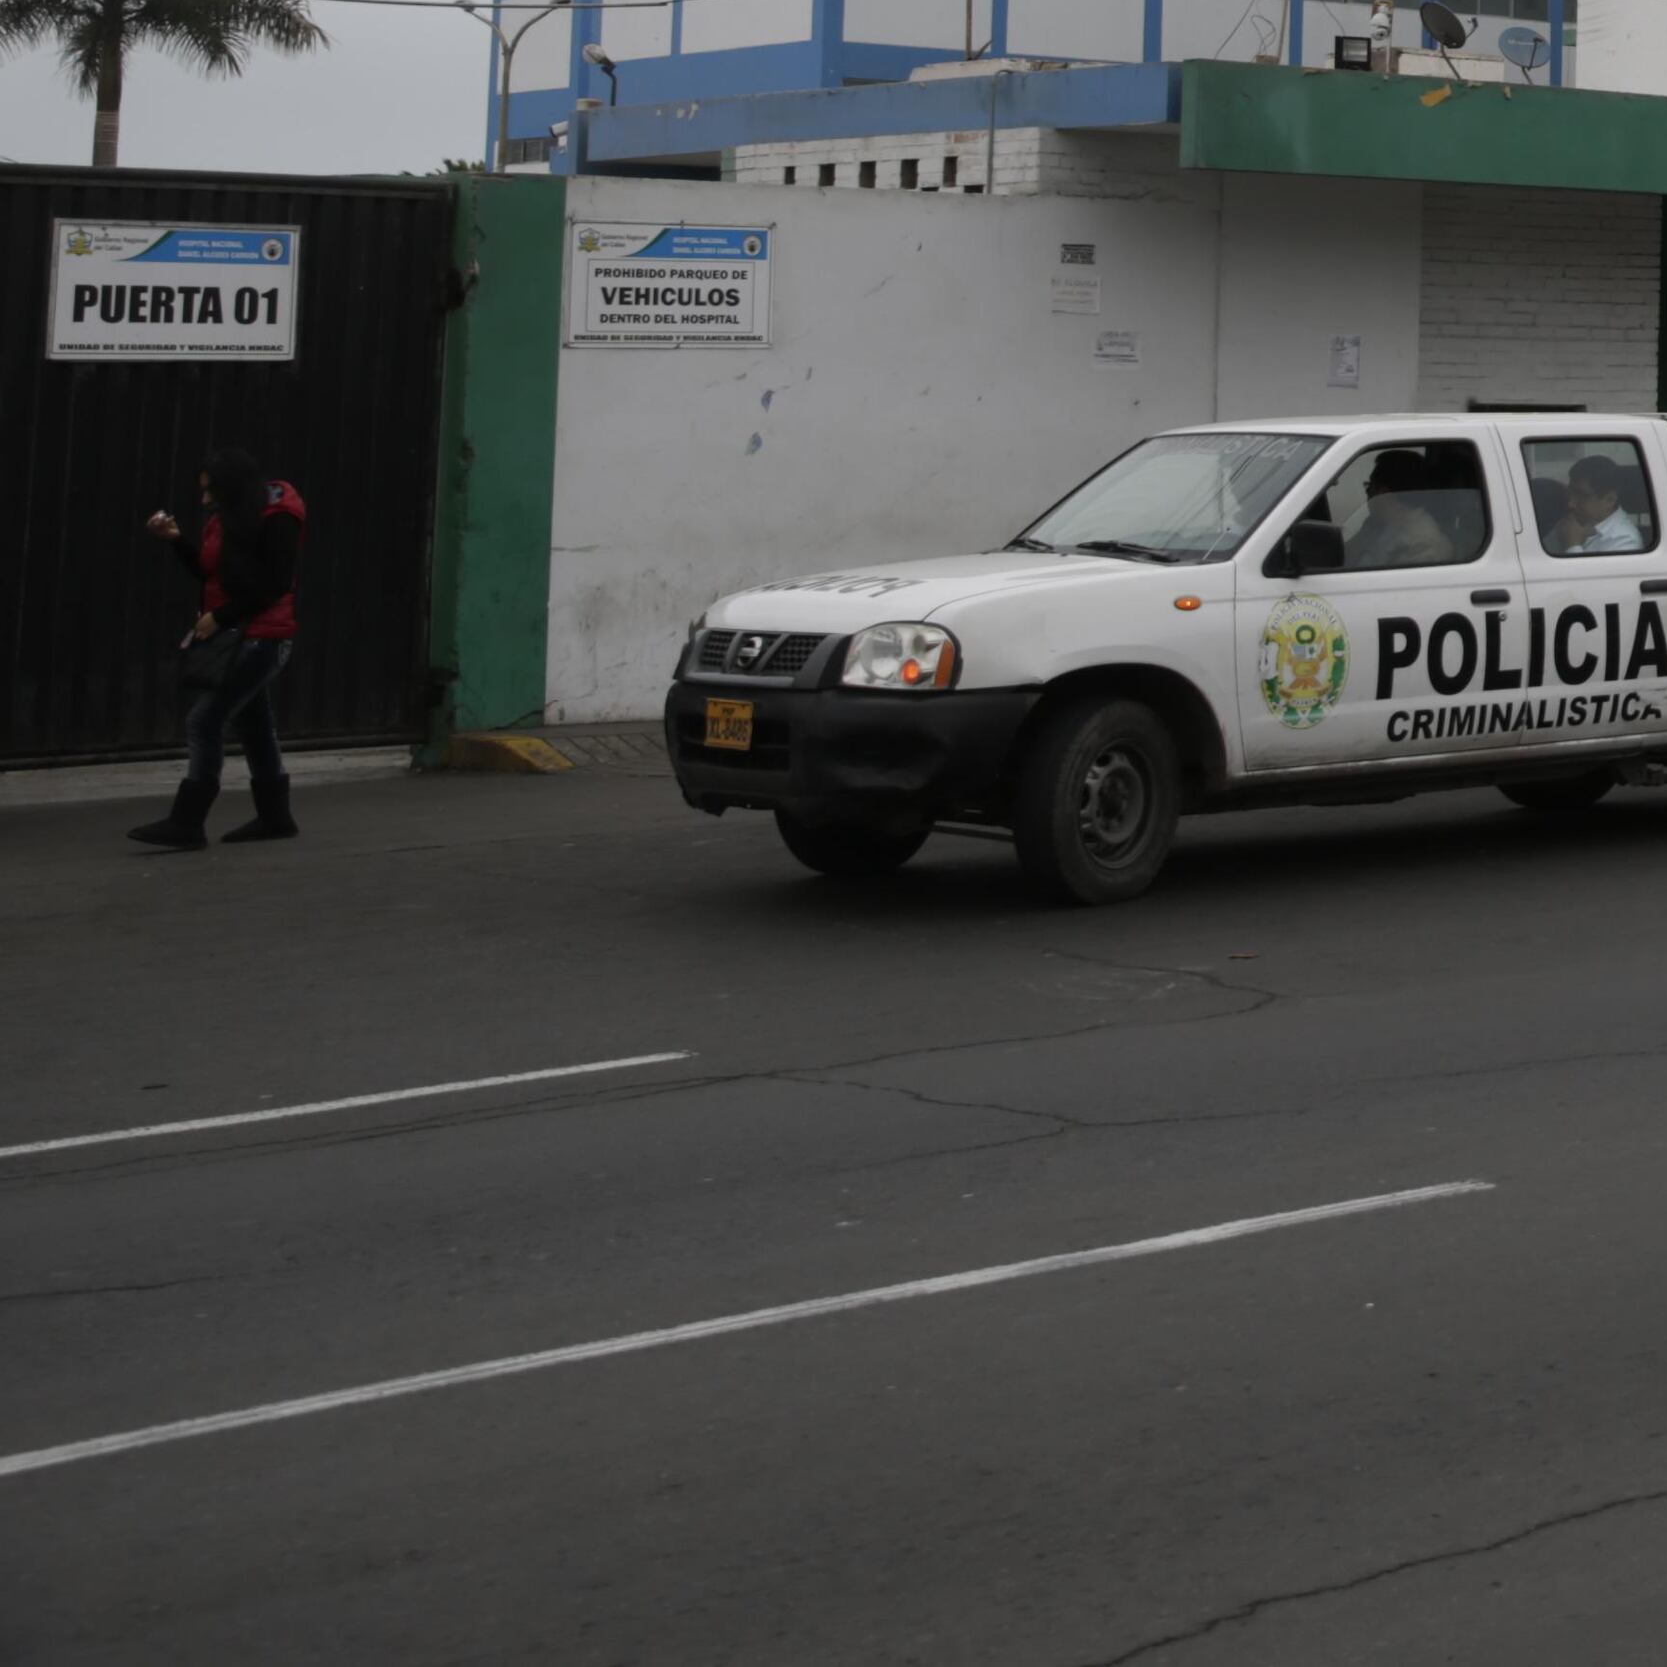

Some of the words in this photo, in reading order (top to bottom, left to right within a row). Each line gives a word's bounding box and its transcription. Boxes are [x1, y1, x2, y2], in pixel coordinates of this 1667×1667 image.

[594, 268, 666, 279] PROHIBIDO
[669, 269, 728, 280] PARQUEO
[731, 270, 749, 280] DE
[73, 284, 223, 324] PUERTA
[234, 286, 278, 325] 01
[601, 287, 740, 306] VEHICULOS
[600, 313, 650, 325] DENTRO
[654, 314, 677, 324] DEL
[681, 314, 740, 325] HOSPITAL
[1387, 691, 1662, 742] CRIMINALISTICA
